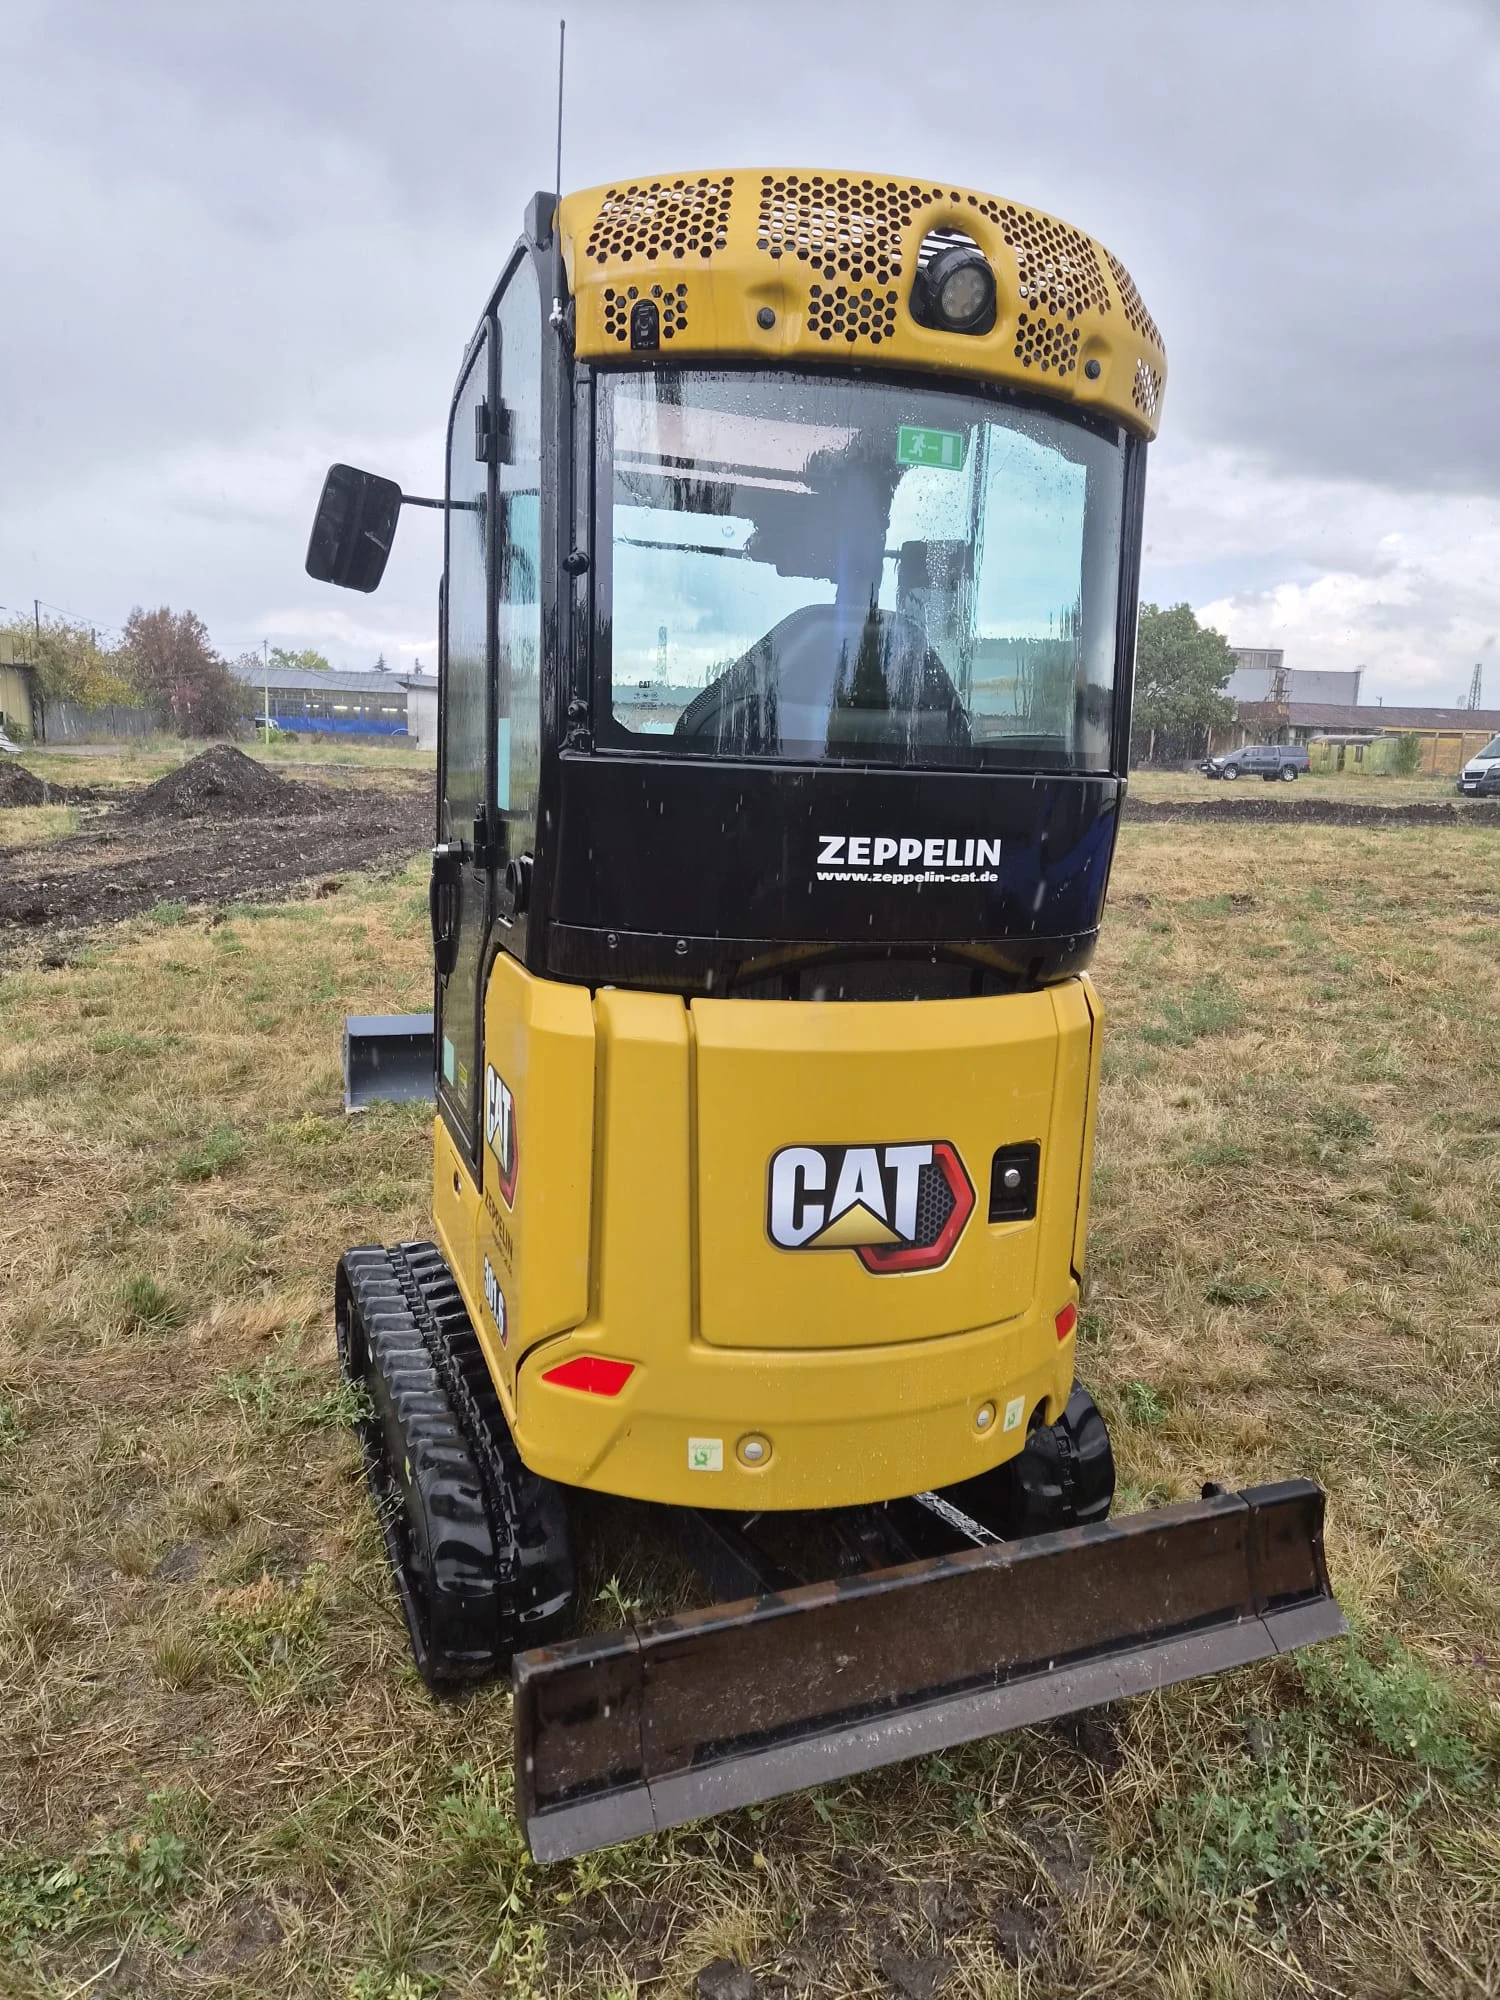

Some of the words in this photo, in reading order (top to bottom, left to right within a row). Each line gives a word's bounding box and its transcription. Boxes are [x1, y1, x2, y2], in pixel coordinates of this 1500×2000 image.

[639, 681, 650, 689] CAT
[816, 871, 999, 884] www.zeppelin-cat.de
[817, 836, 1002, 866] ZEPPELIN
[487, 1064, 512, 1173] CAT
[485, 1186, 513, 1260] ZEPPELIN
[772, 1145, 933, 1247] CAT
[484, 1255, 504, 1337] 301.6
